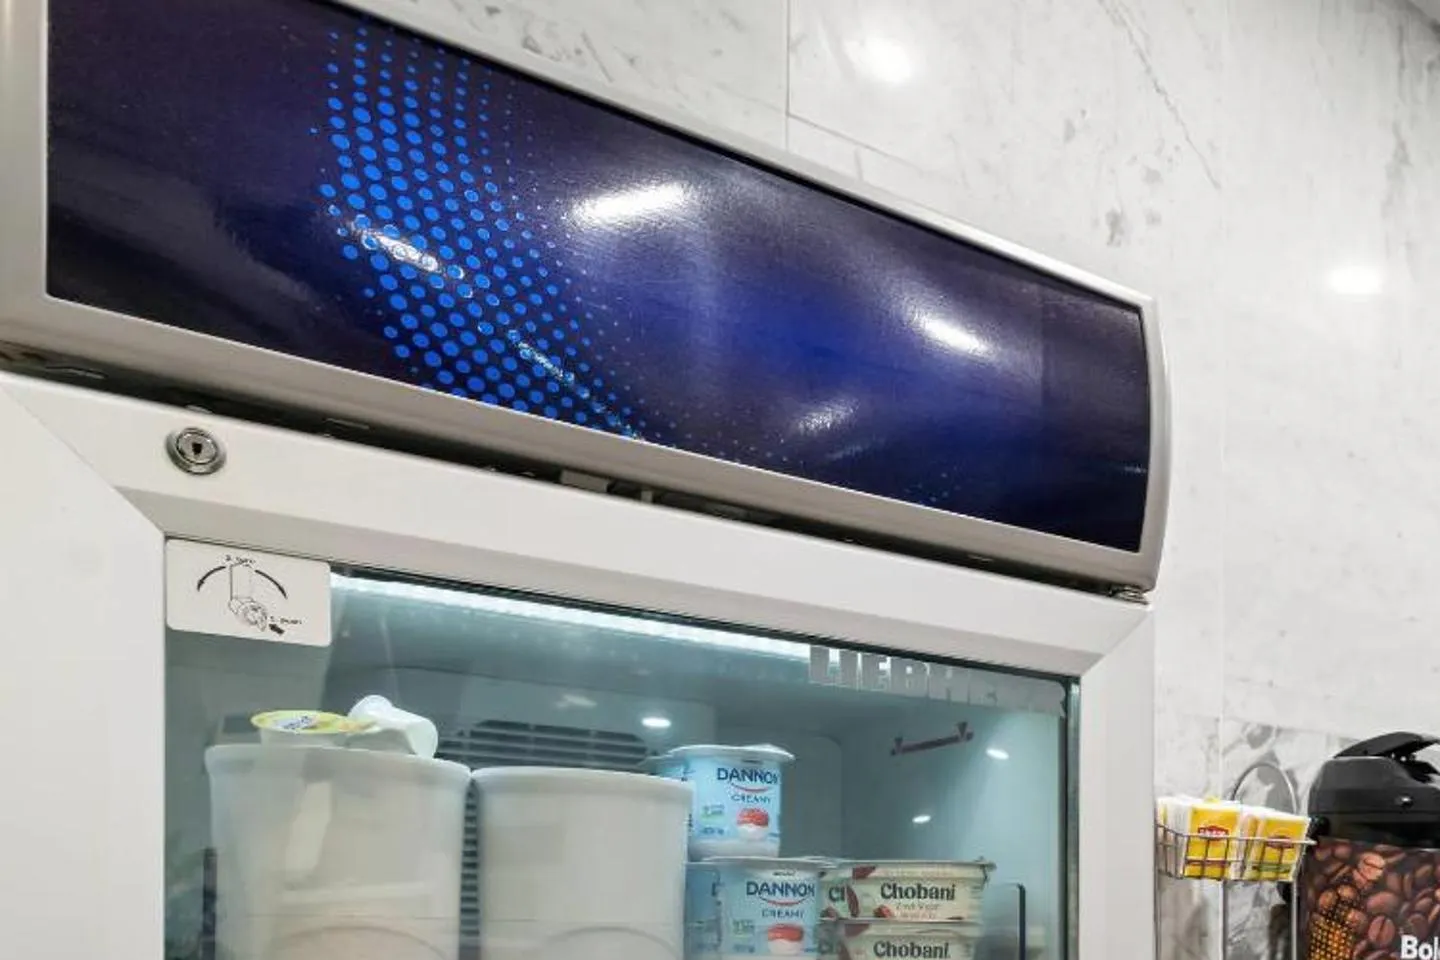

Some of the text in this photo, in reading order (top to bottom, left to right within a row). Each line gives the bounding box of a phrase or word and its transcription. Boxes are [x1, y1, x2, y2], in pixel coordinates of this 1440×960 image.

[716, 767, 778, 786] DANNON
[745, 881, 816, 898] DANNON
[880, 882, 956, 901] Chobani
[761, 908, 805, 919] CREAMY
[873, 940, 949, 959] Chobani
